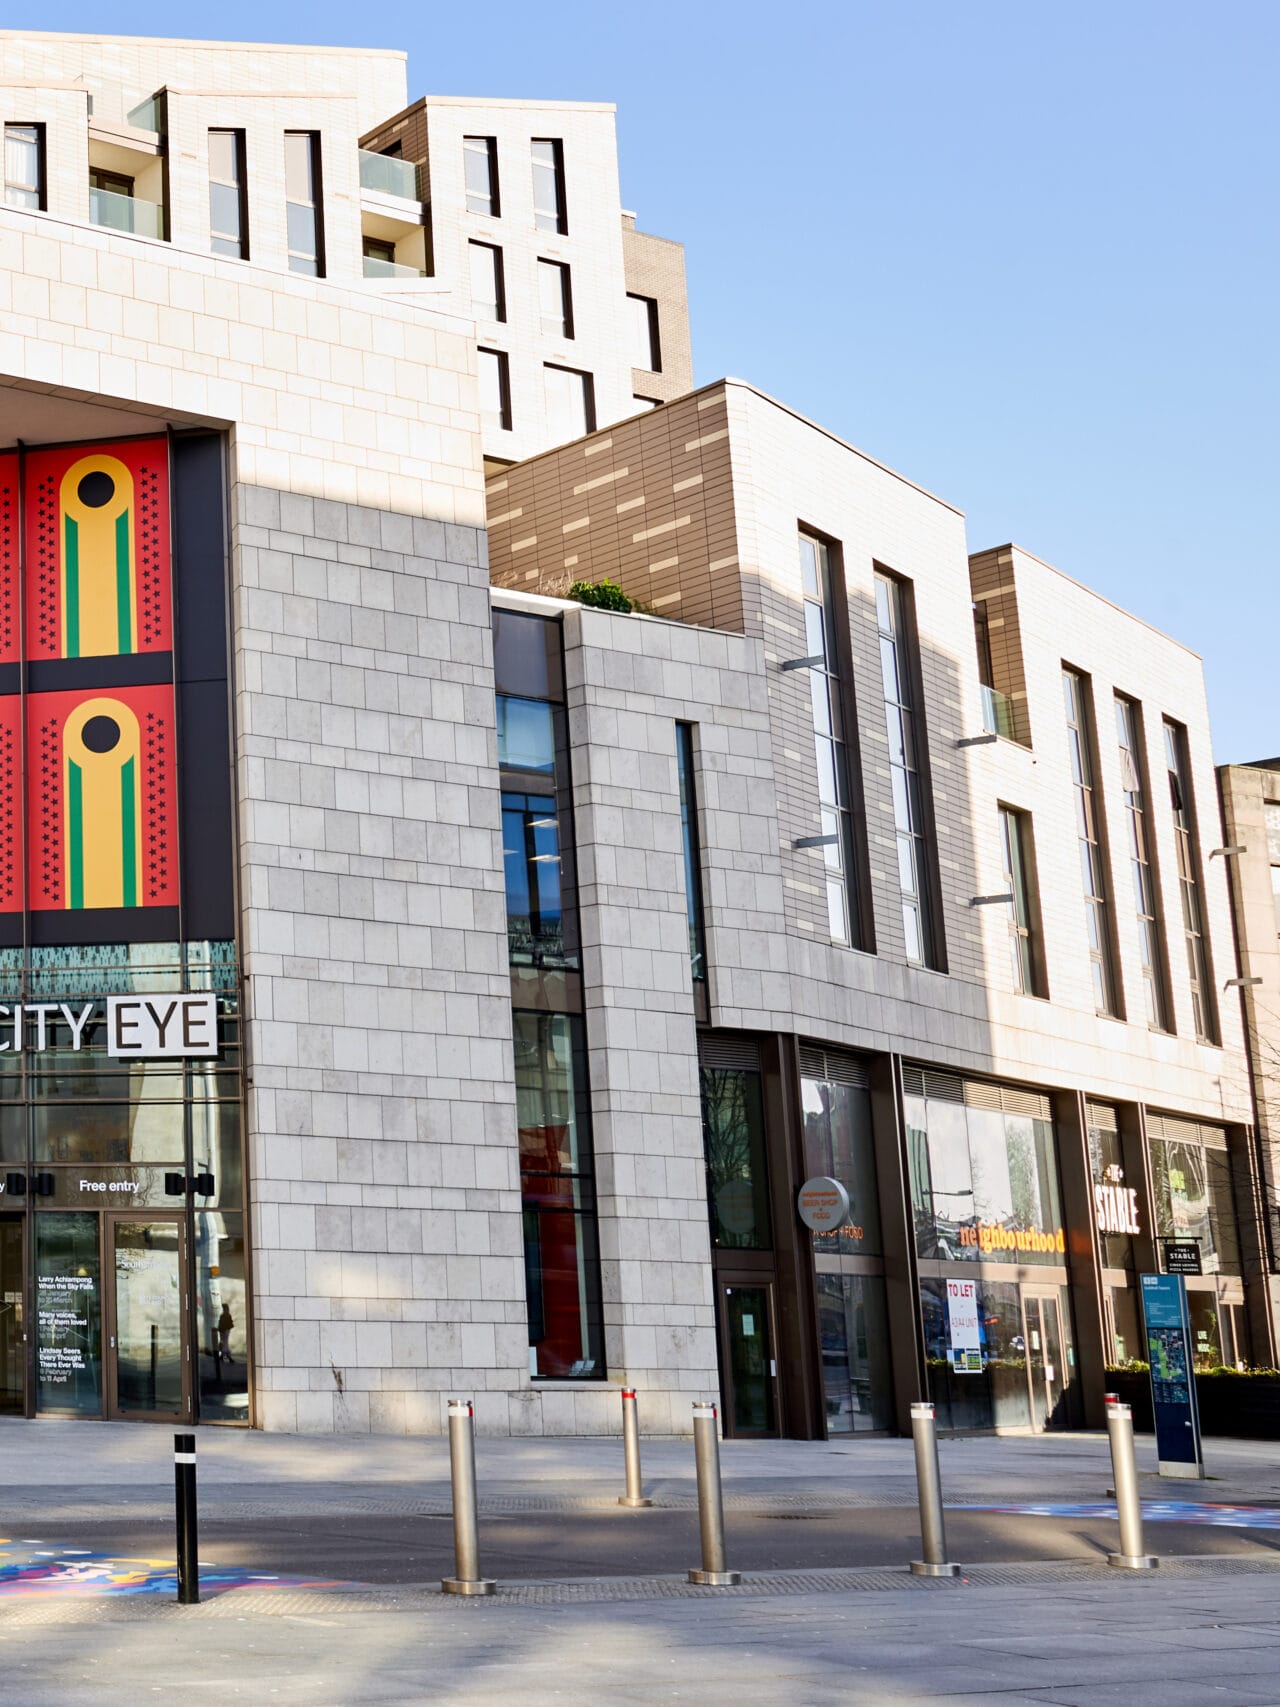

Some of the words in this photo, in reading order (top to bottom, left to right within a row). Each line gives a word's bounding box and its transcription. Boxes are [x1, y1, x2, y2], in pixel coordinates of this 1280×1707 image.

[116, 1001, 210, 1049] EYE
[79, 1180, 107, 1191] Free
[109, 1180, 140, 1194] entry
[1095, 1184, 1141, 1235] STABLE
[959, 1221, 1065, 1254] neighbourhood
[38, 1276, 54, 1284] Larry
[67, 1283, 79, 1291] Sky
[948, 1283, 959, 1297] TO
[960, 1284, 974, 1297] LET
[38, 1311, 55, 1319] Many
[39, 1347, 62, 1355] Lindsay
[39, 1354, 57, 1362] Every
[57, 1354, 82, 1362] Thought
